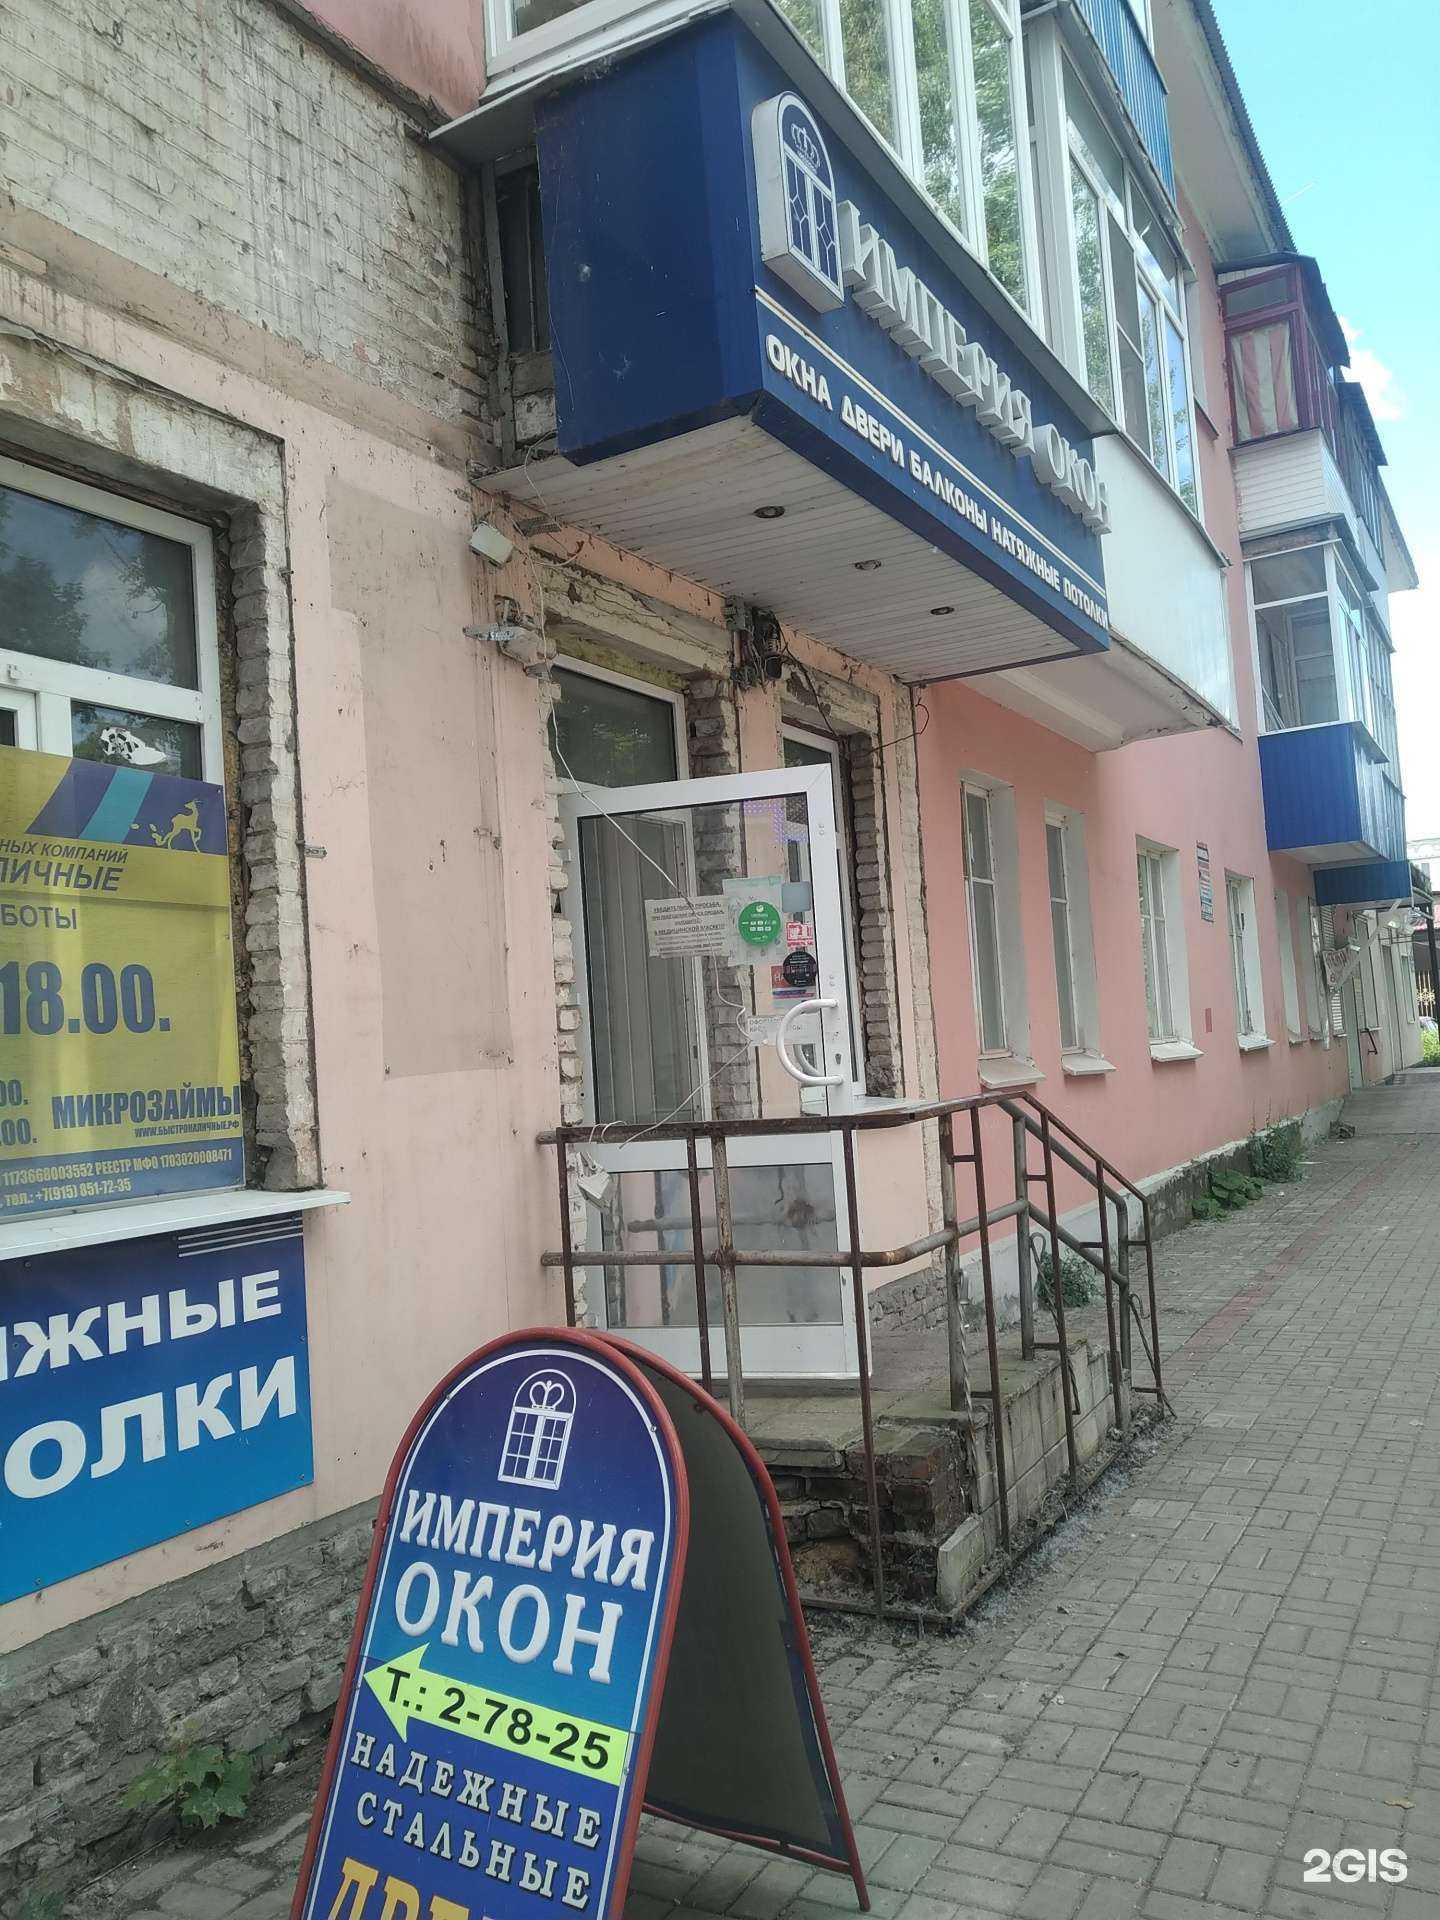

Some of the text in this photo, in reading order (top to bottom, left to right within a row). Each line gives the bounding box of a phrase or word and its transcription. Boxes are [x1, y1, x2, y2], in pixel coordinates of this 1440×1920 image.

[837, 200, 1036, 457] ИМПЕРИЯ
[766, 334, 1109, 630] ОКНА ДВЕРИ БАЛКОНЫ НАТЯЖНЫЕ ПОТОЛКИ
[40, 842, 129, 864] КОМПАНИЙ
[0, 903, 77, 930] БОТЫ
[0, 961, 171, 1035] 18.00.
[52, 1082, 240, 1129] МИКРОЗАЙМЫ
[79, 1177, 132, 1198] 851-72-35
[95, 1158, 132, 1176] РЕЕСТР
[134, 1154, 159, 1172] МФО
[0, 1269, 283, 1382] ЖНЫЕ
[4, 1355, 297, 1499] ОЛКИ
[400, 1489, 655, 1591] ИМПЕРИЯ
[394, 1561, 623, 1684] ОКОН
[386, 1667, 612, 1770] Т.: 2-78-25
[350, 1732, 602, 1848] НАДЕЖНЫЕ
[356, 1792, 592, 1910] СТАЛЬНЫЕ
